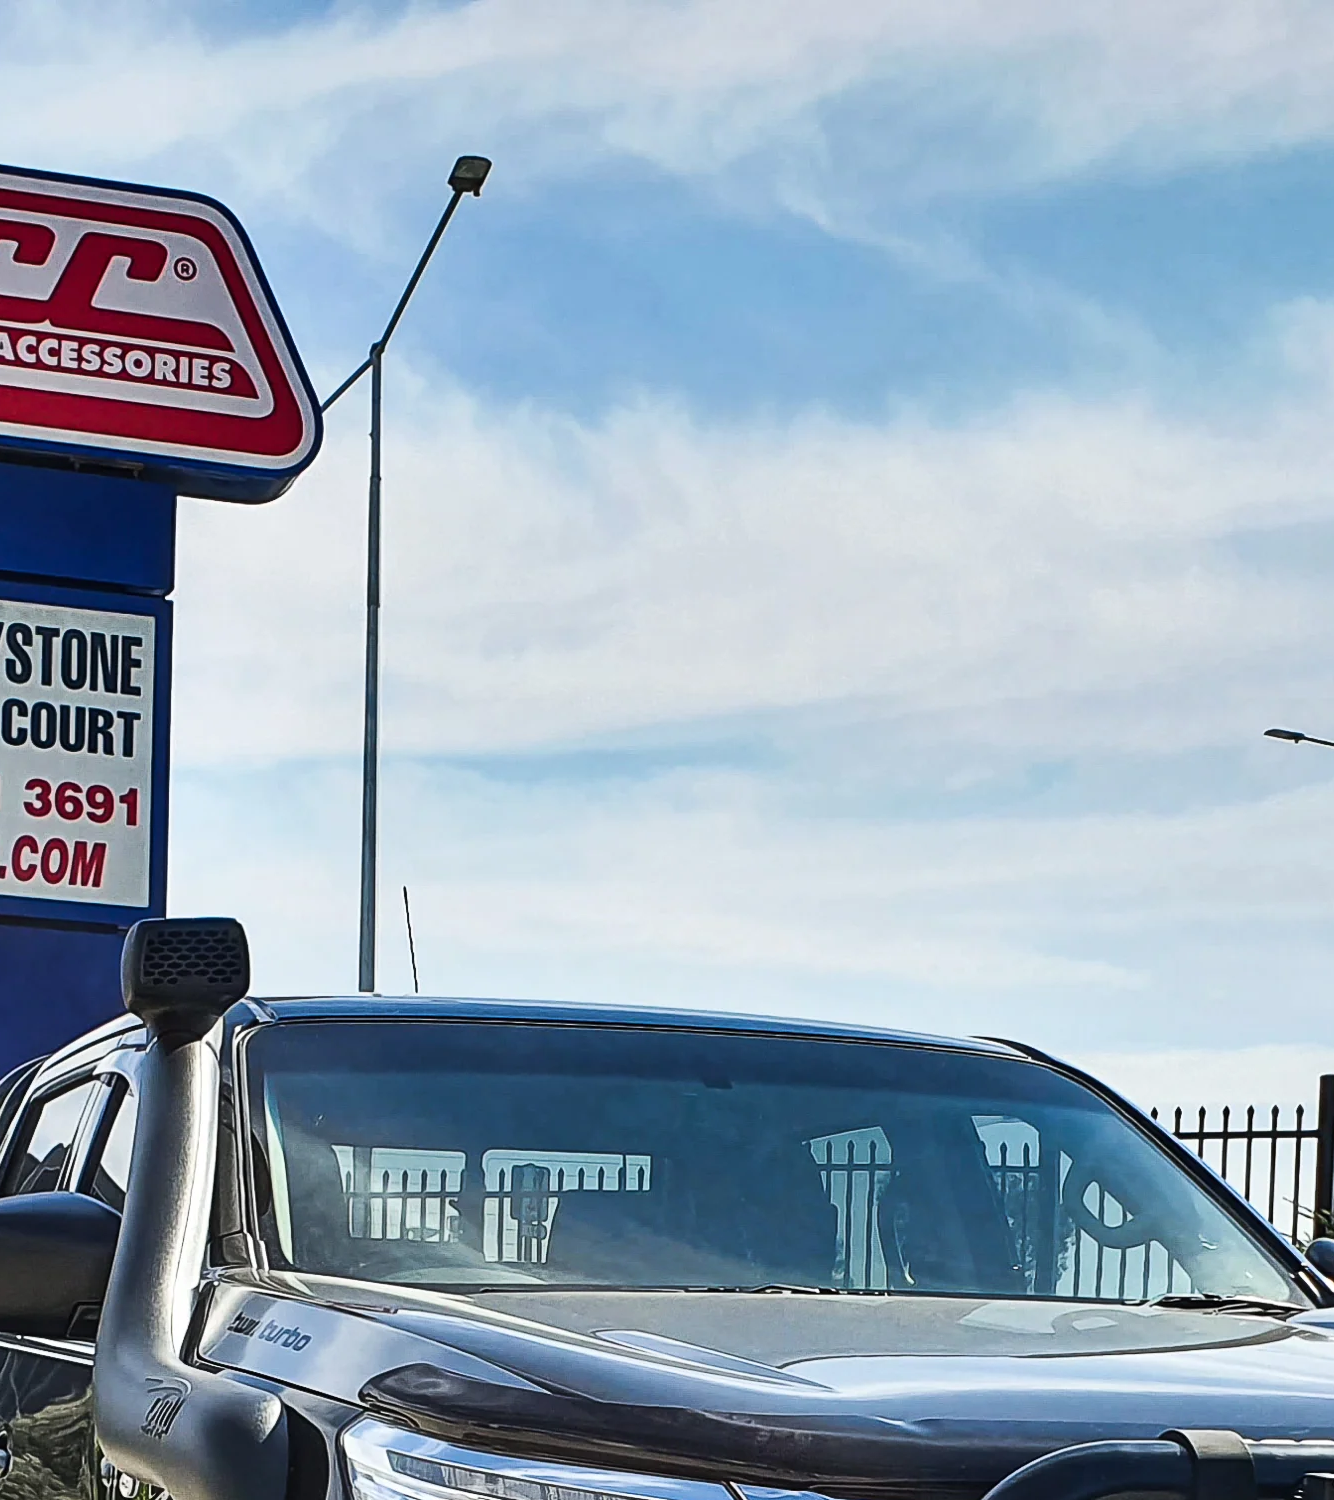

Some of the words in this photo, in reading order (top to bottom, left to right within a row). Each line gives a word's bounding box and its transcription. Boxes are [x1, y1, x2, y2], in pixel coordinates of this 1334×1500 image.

[1, 698, 142, 758] COURT
[23, 778, 139, 826] 3691
[258, 1319, 312, 1351] turbo
